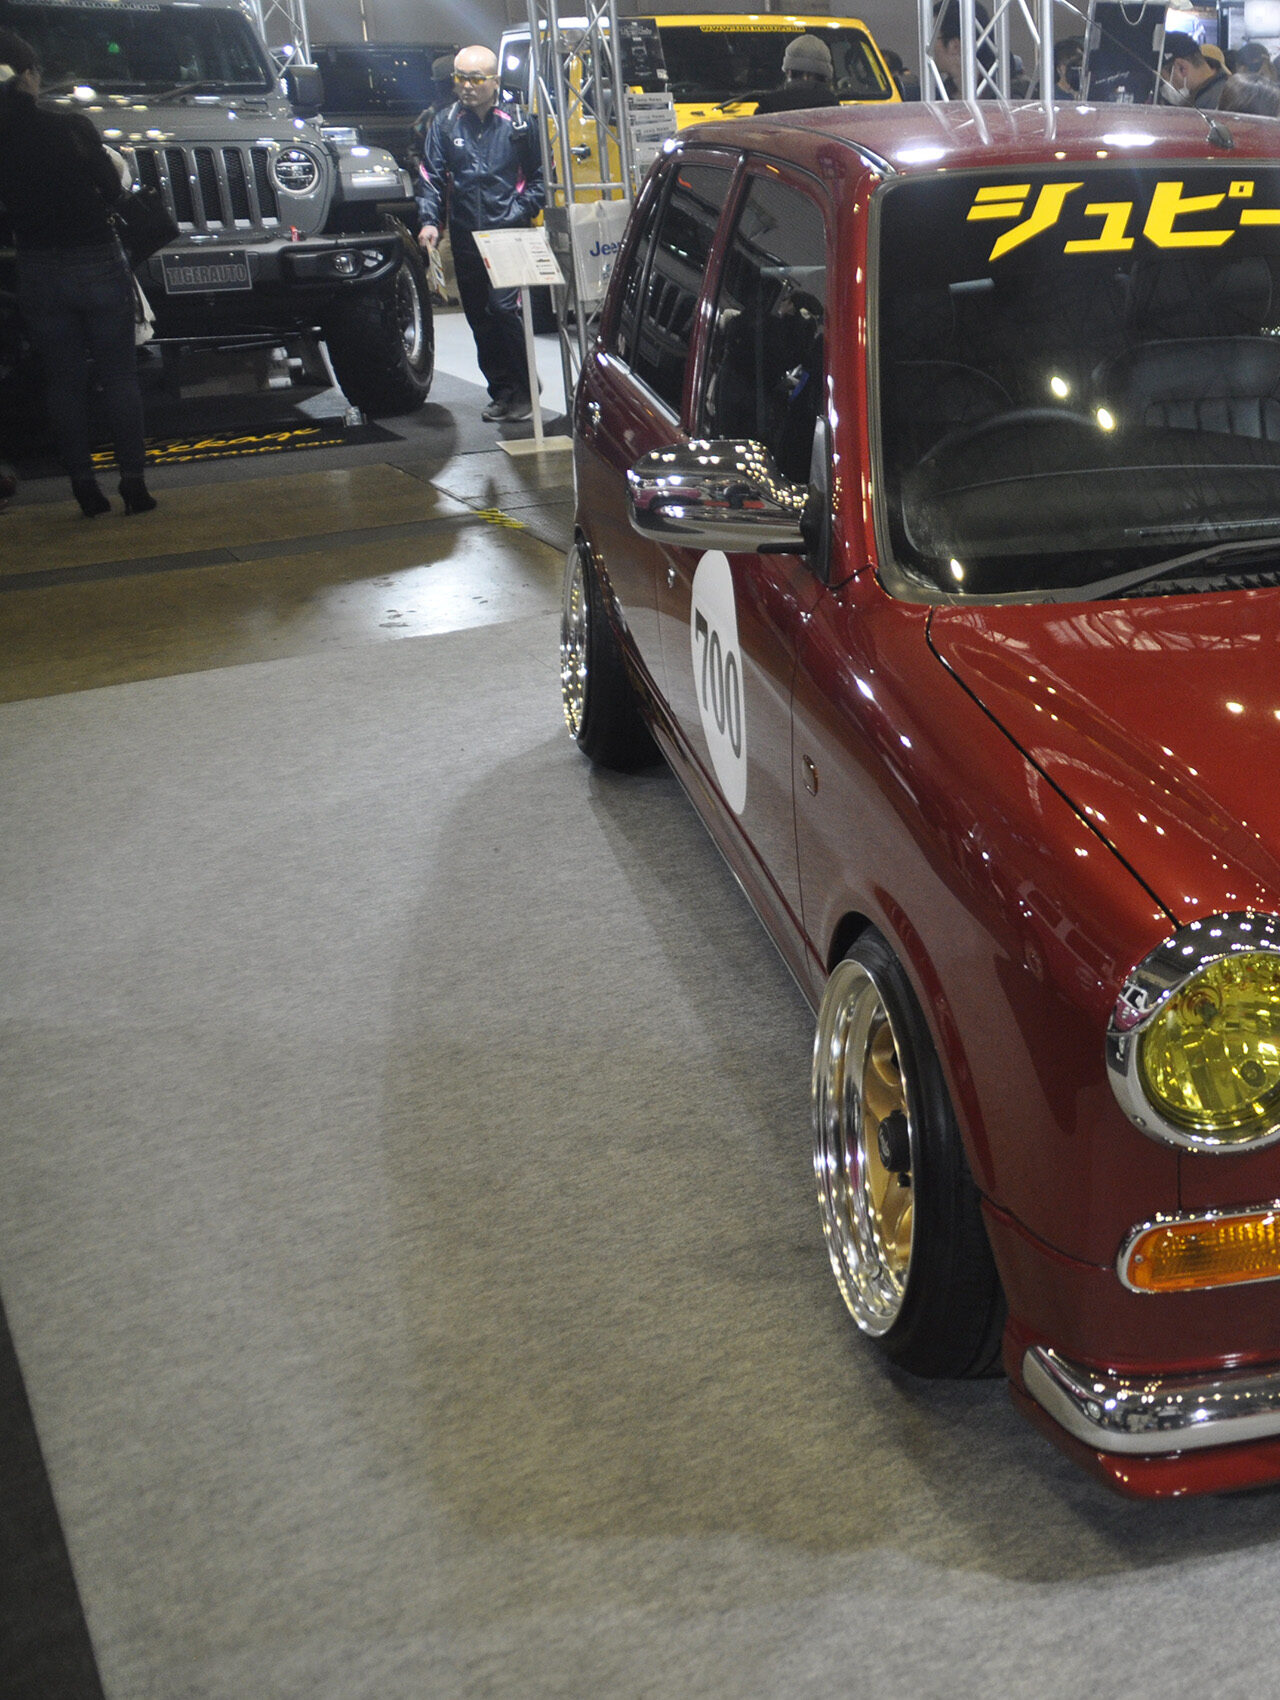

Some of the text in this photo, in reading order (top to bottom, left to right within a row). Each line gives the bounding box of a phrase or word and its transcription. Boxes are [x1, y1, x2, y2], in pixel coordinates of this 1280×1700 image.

[589, 240, 622, 257] Jee
[165, 264, 248, 286] TIGERAUTO
[695, 607, 742, 759] 700
